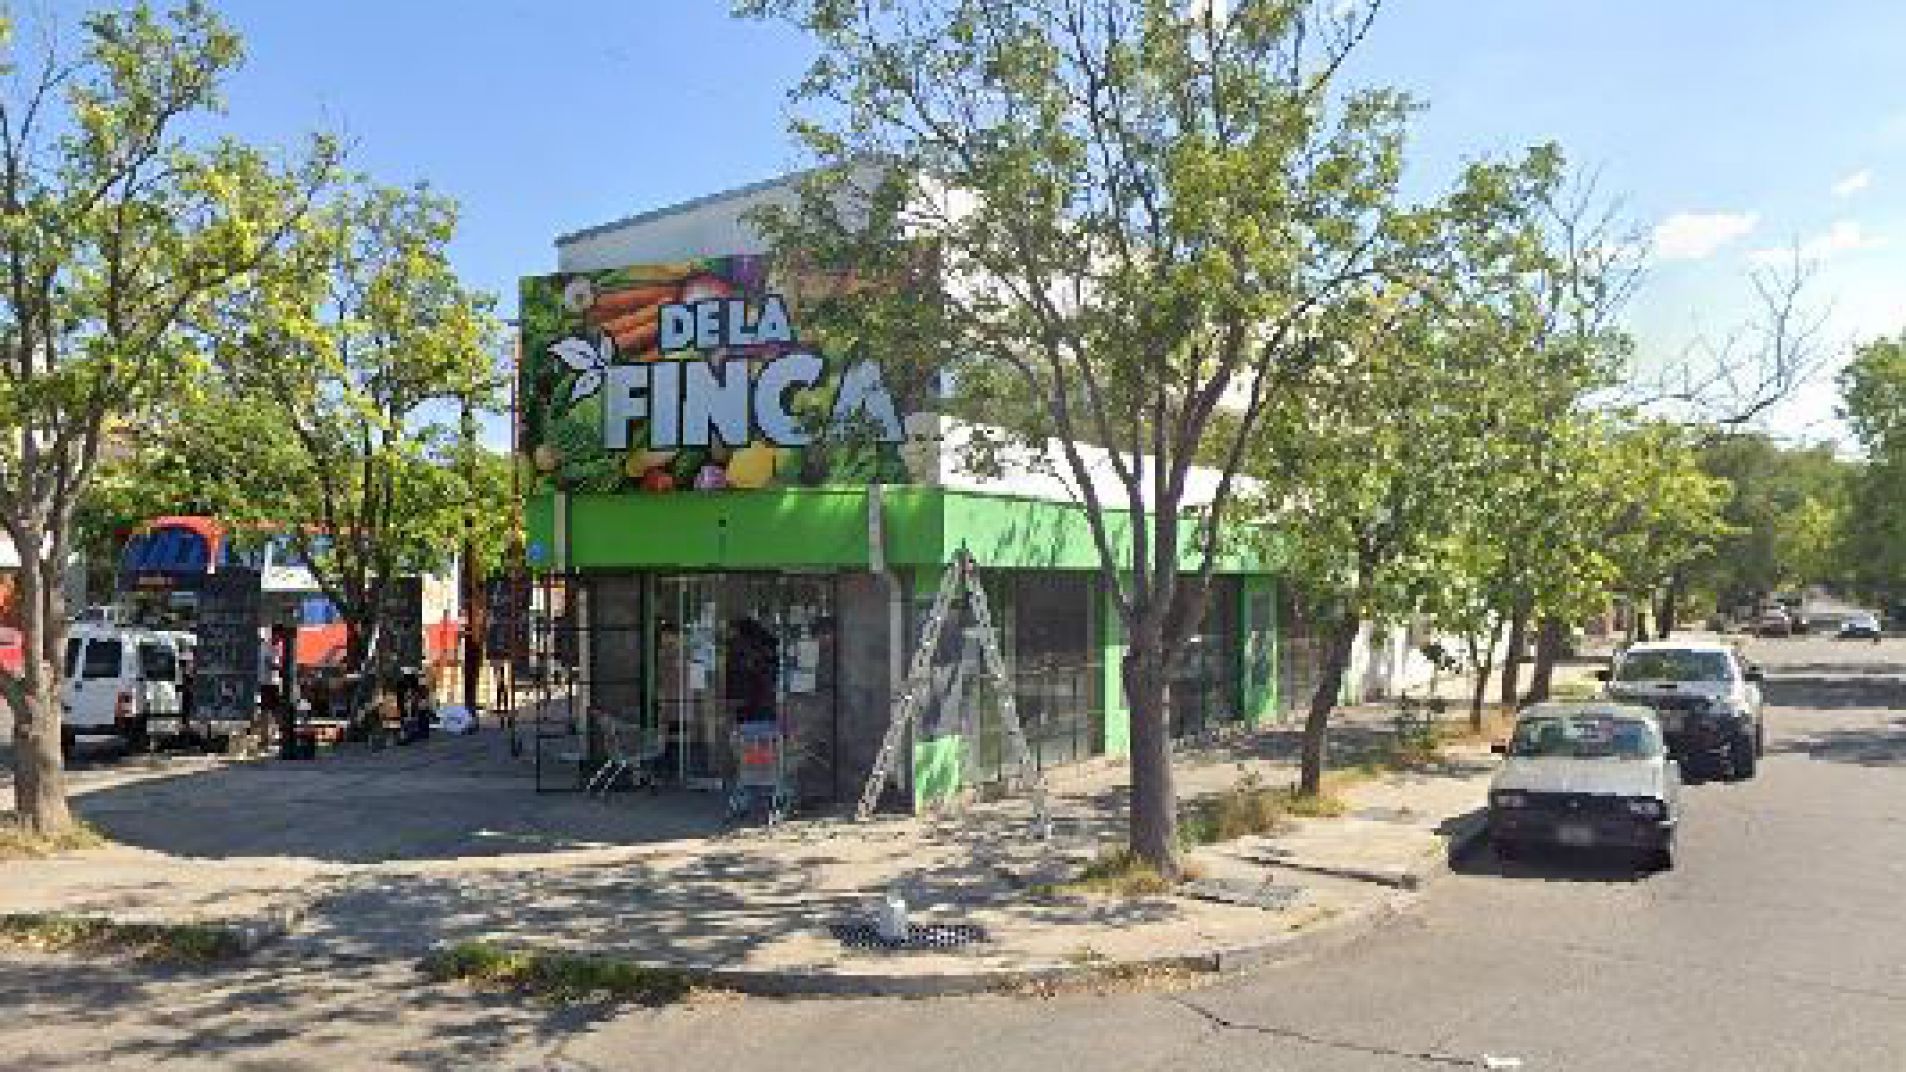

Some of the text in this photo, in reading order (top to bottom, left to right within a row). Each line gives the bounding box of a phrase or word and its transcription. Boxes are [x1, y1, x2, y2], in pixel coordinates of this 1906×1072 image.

[661, 296, 791, 348] DE LA
[604, 353, 902, 449] FINCA
